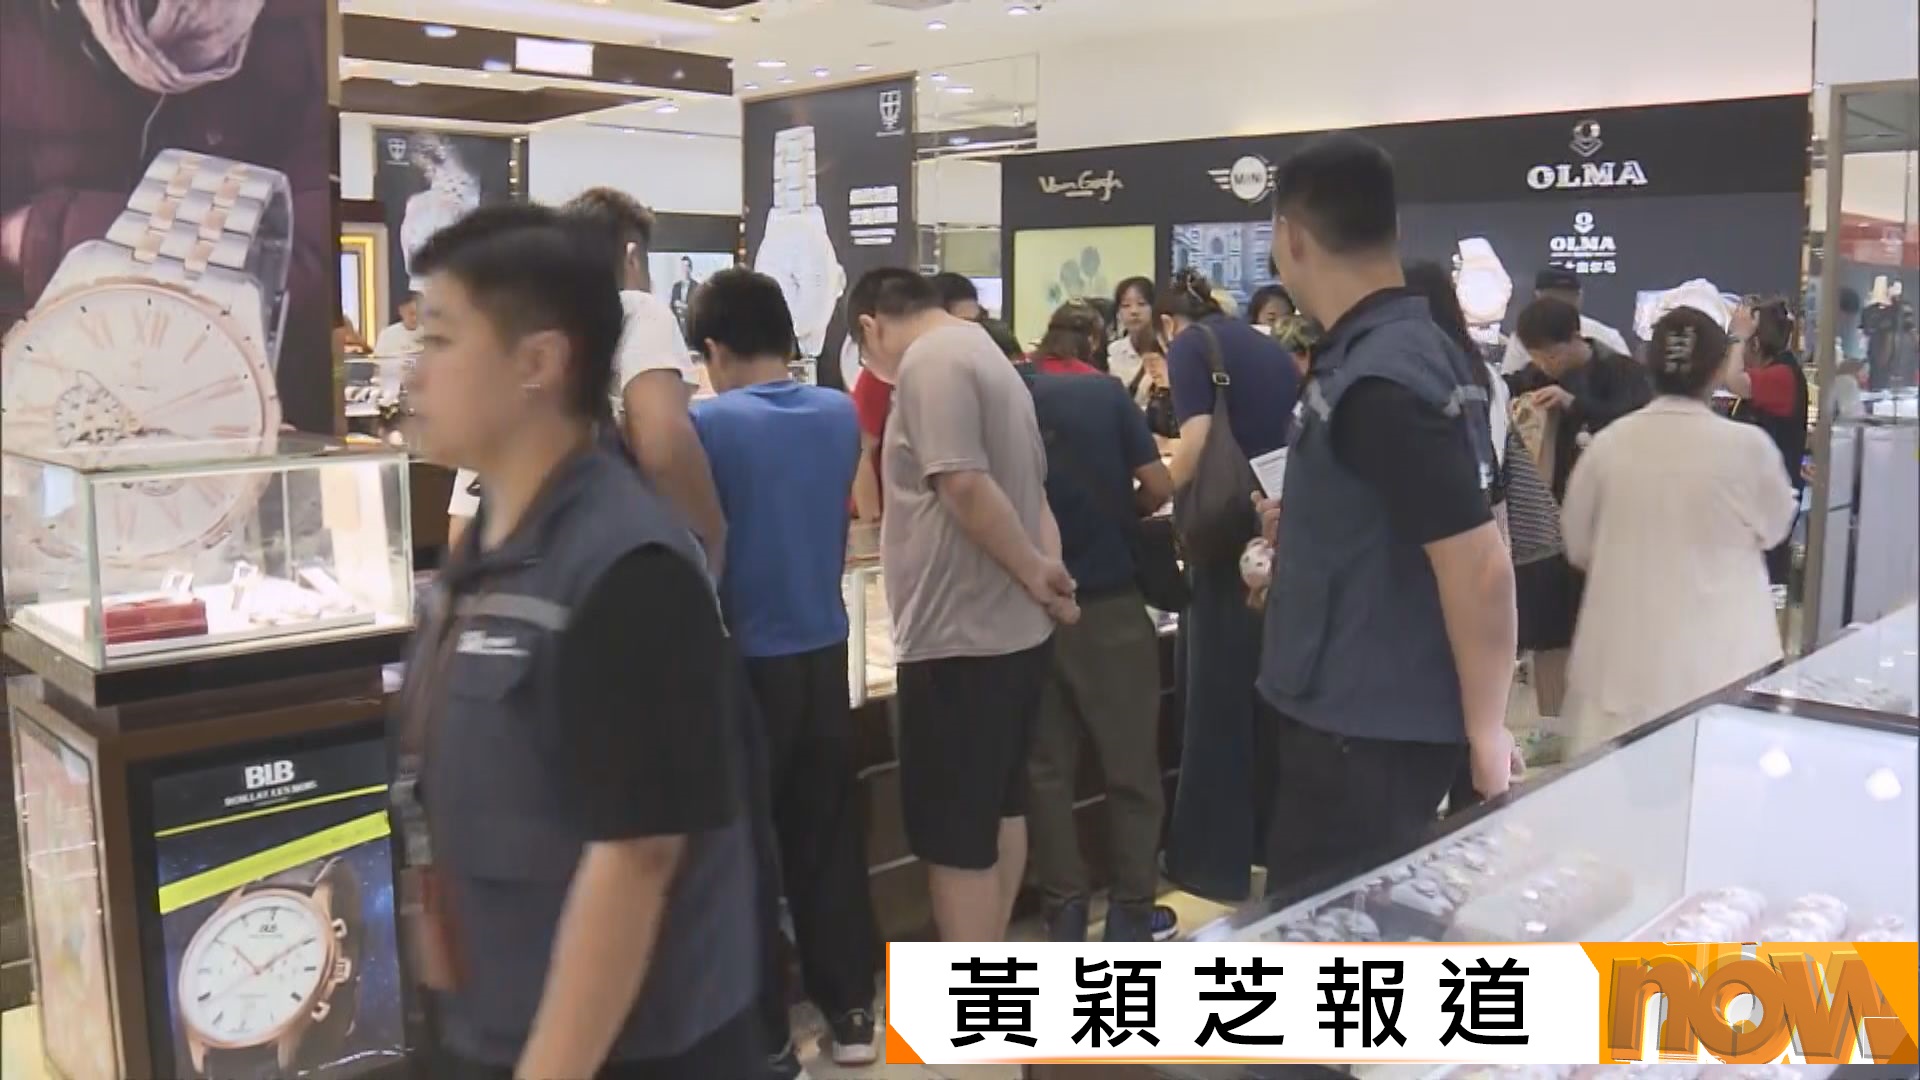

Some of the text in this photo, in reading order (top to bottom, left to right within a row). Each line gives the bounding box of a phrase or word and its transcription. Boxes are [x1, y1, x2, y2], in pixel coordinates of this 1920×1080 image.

[1527, 160, 1649, 190] OLMA
[1550, 236, 1617, 251] OLMA
[245, 760, 295, 789] BLB
